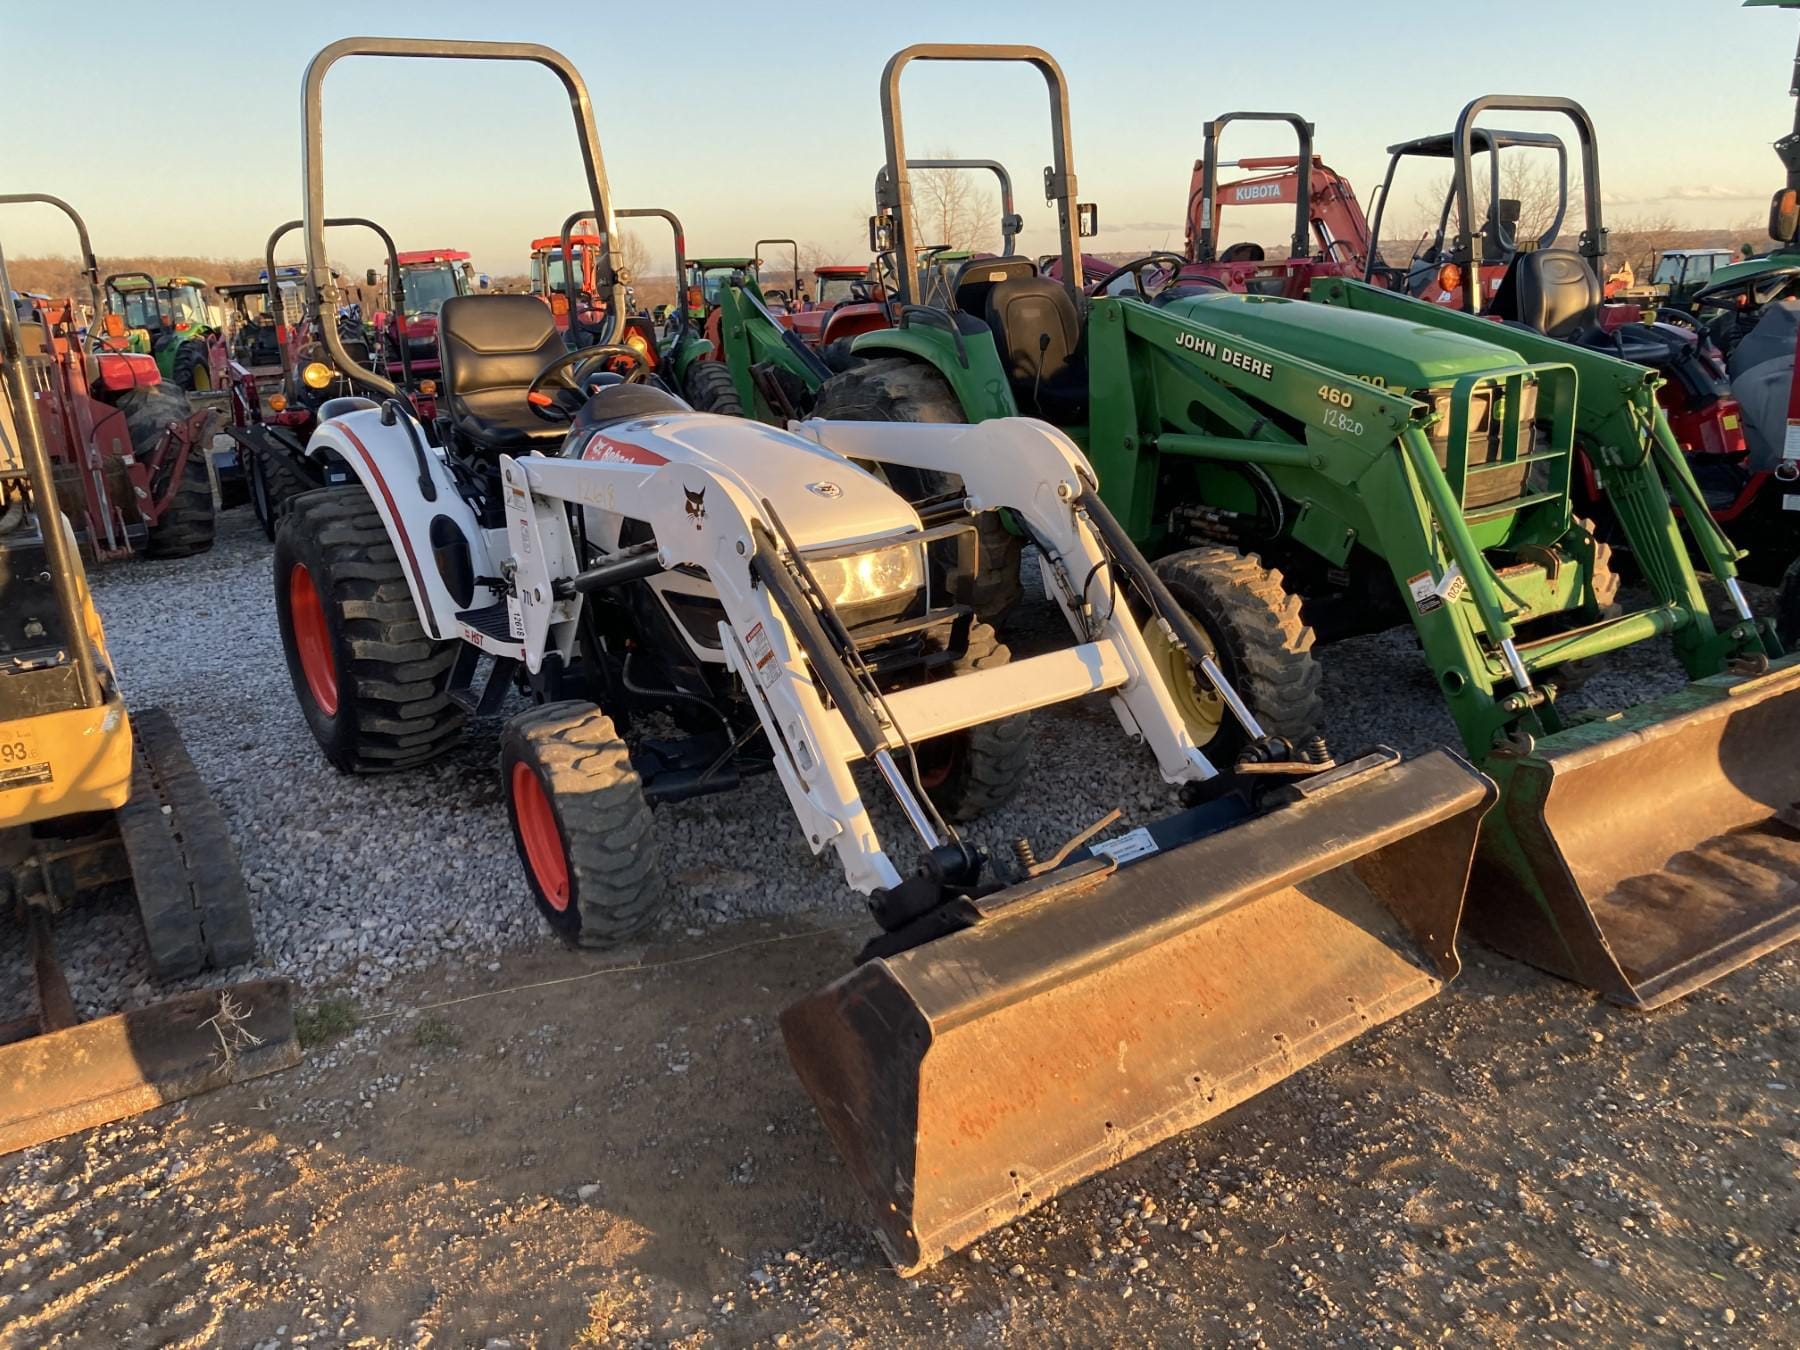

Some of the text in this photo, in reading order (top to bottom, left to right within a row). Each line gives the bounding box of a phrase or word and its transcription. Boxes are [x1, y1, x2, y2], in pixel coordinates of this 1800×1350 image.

[1236, 184, 1281, 200] KUBOTA
[1175, 332, 1273, 379] JOHN DEERE
[1318, 385, 1353, 408] 460
[1323, 408, 1364, 436] 12820
[1, 742, 27, 763] 93
